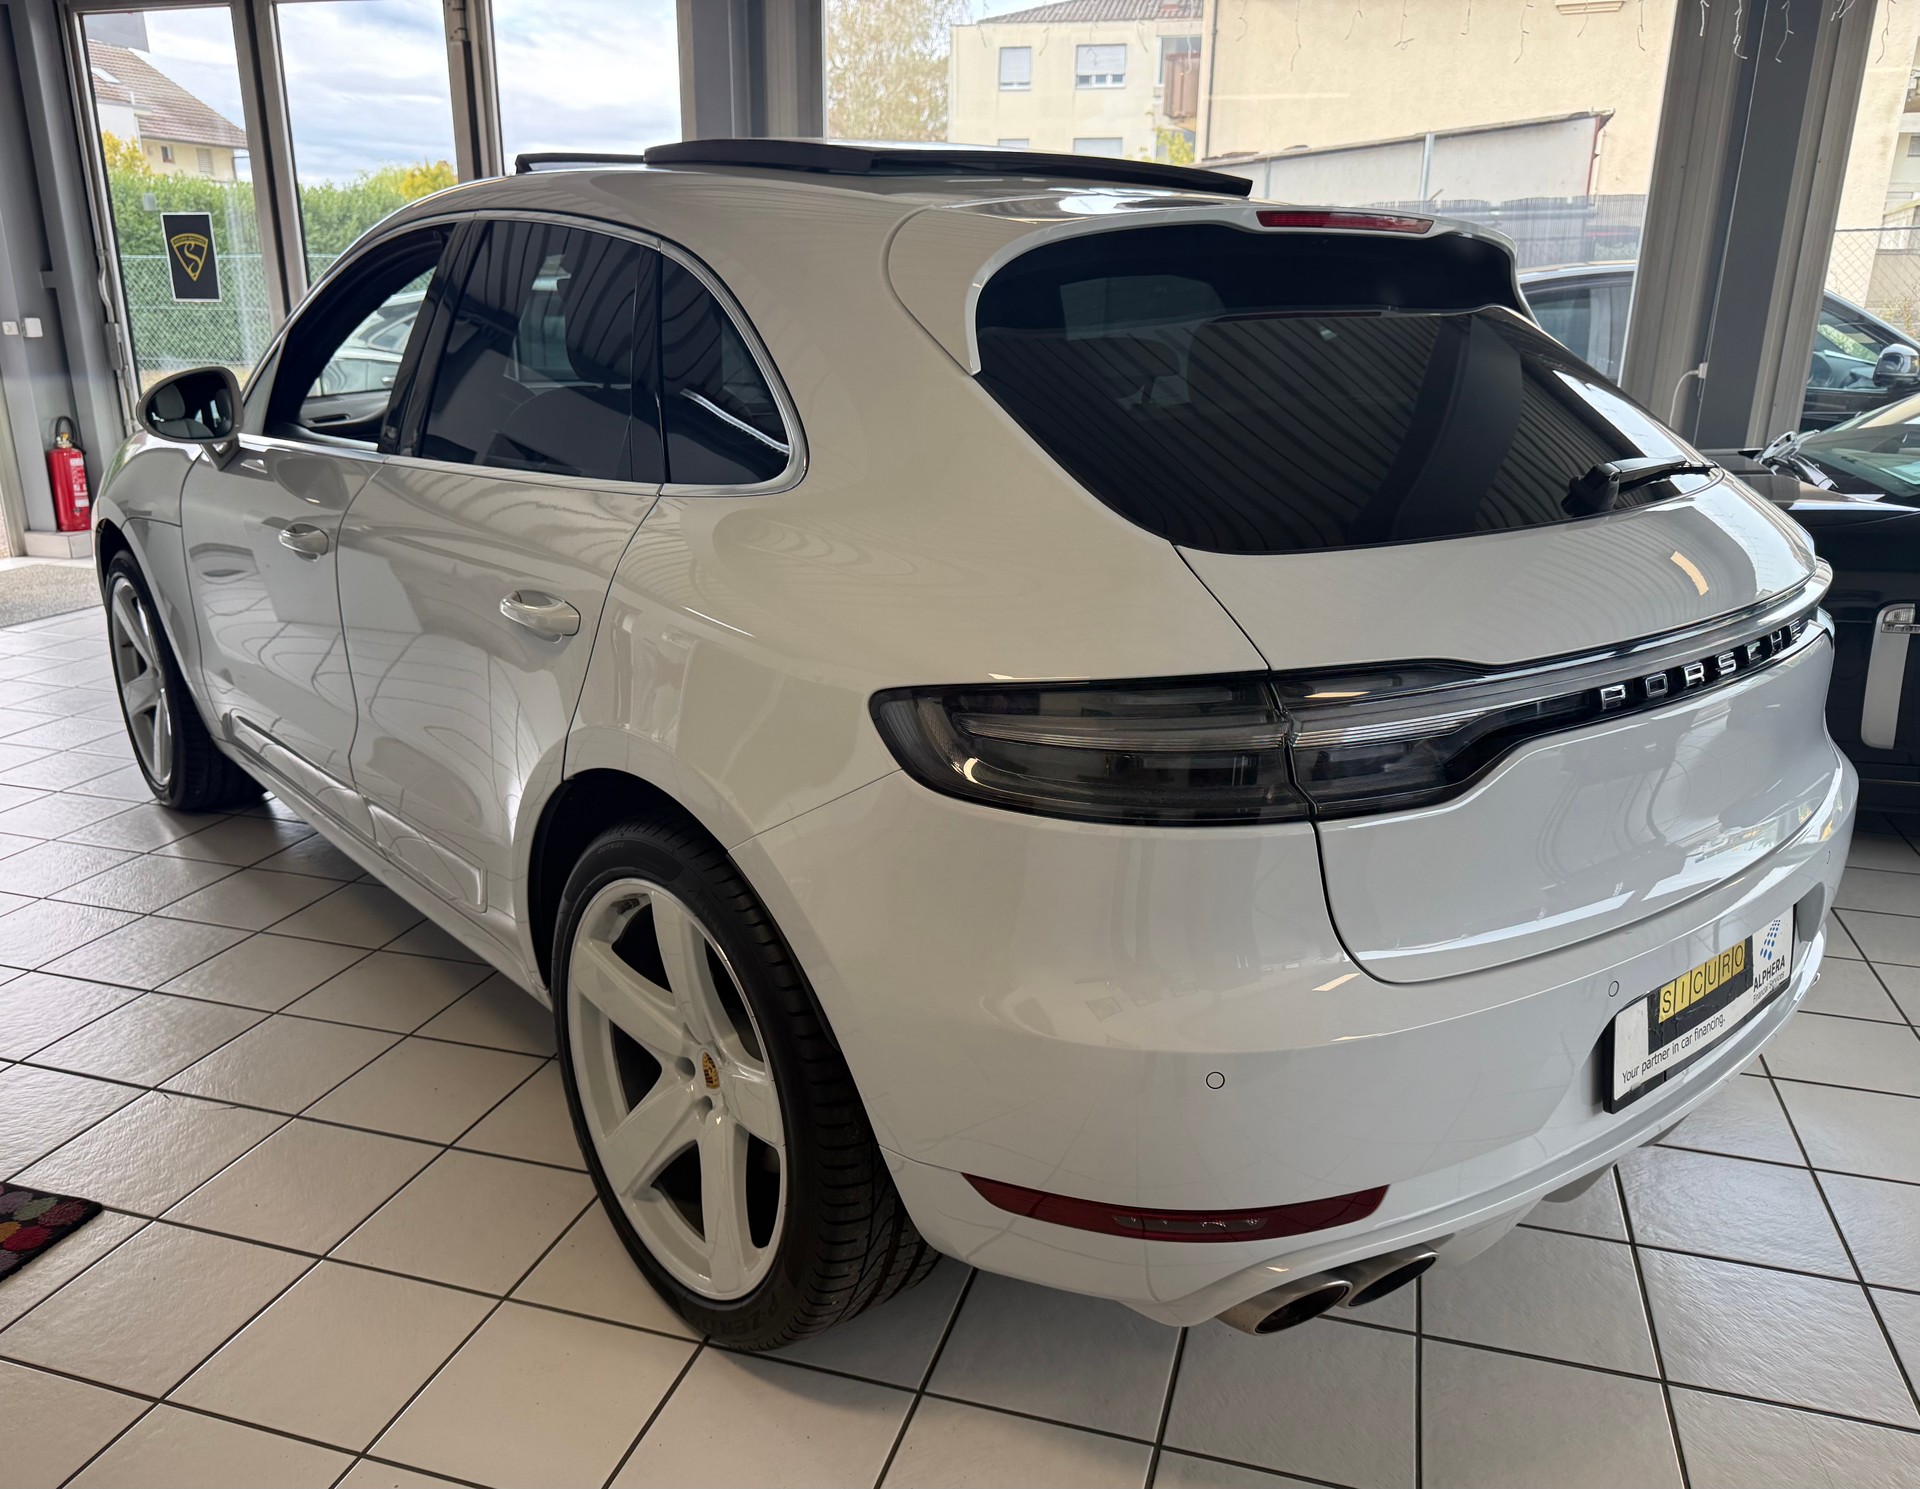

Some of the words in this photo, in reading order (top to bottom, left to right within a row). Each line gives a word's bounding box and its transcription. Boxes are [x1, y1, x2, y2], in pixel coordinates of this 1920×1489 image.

[1601, 619, 1802, 710] PORSCHE
[1662, 945, 1744, 1014] SICURO
[1753, 955, 1785, 993] ALPHERA
[1622, 1065, 1640, 1084] Your
[1641, 1047, 1670, 1075] partner
[1672, 1043, 1679, 1055] in
[1681, 1034, 1693, 1049] car
[1694, 1013, 1726, 1041] financing.
